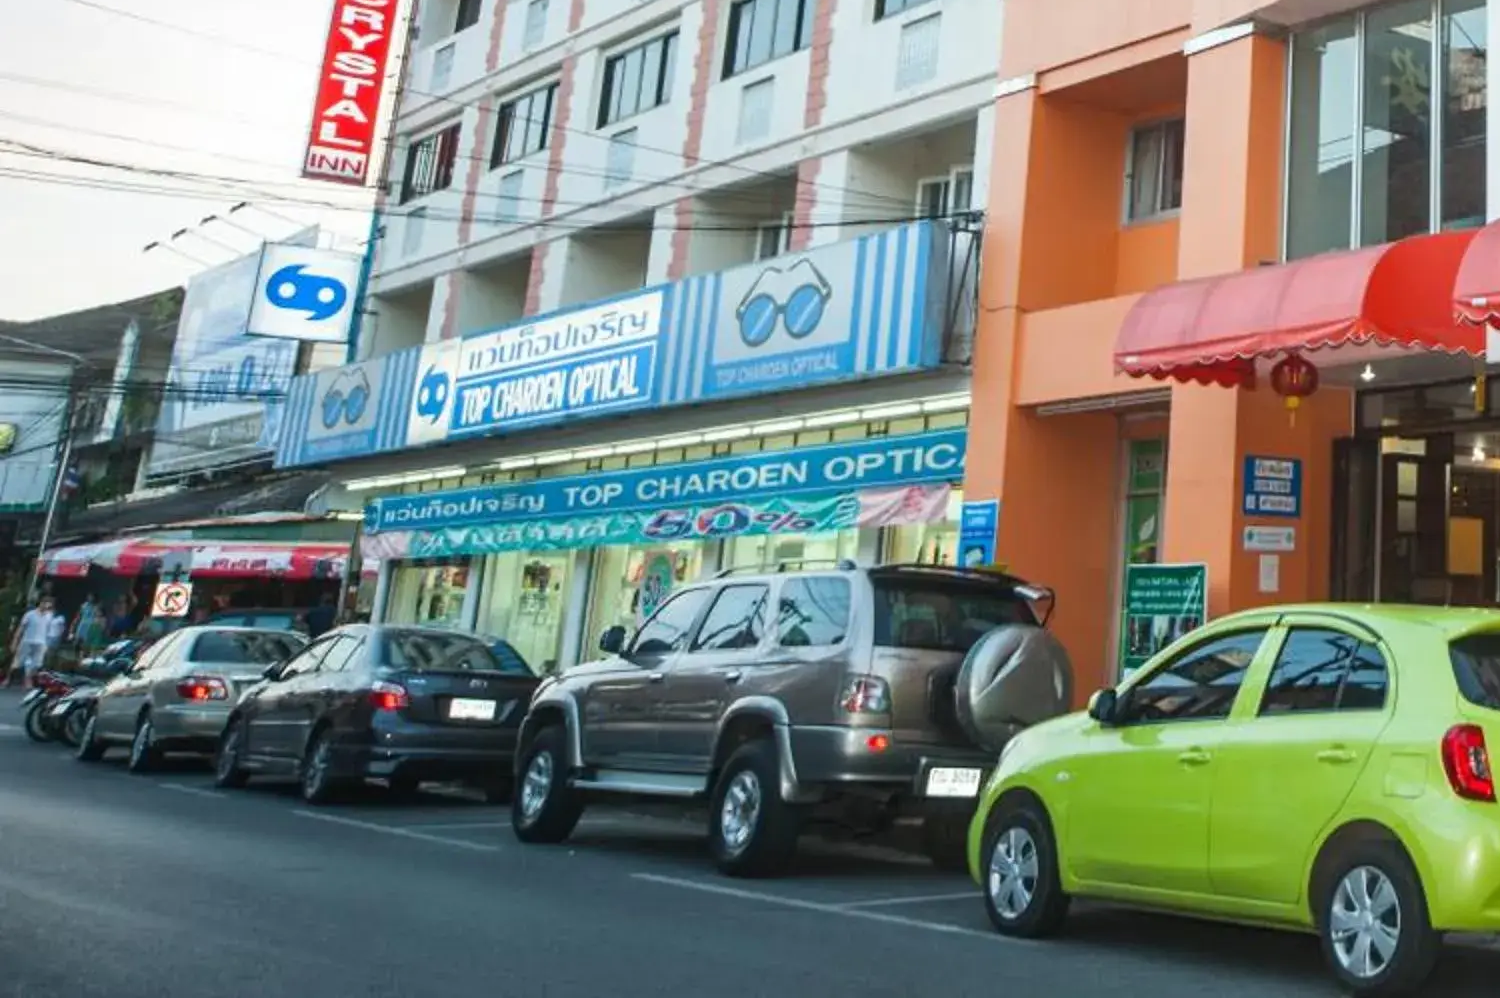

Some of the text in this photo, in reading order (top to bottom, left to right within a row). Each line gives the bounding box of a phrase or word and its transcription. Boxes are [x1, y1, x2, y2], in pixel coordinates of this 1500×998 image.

[308, 153, 364, 176] INN
[460, 353, 640, 425] TOP CHAROEN OPTICAL
[563, 442, 968, 508] TOP CHAROEN OPTIC
